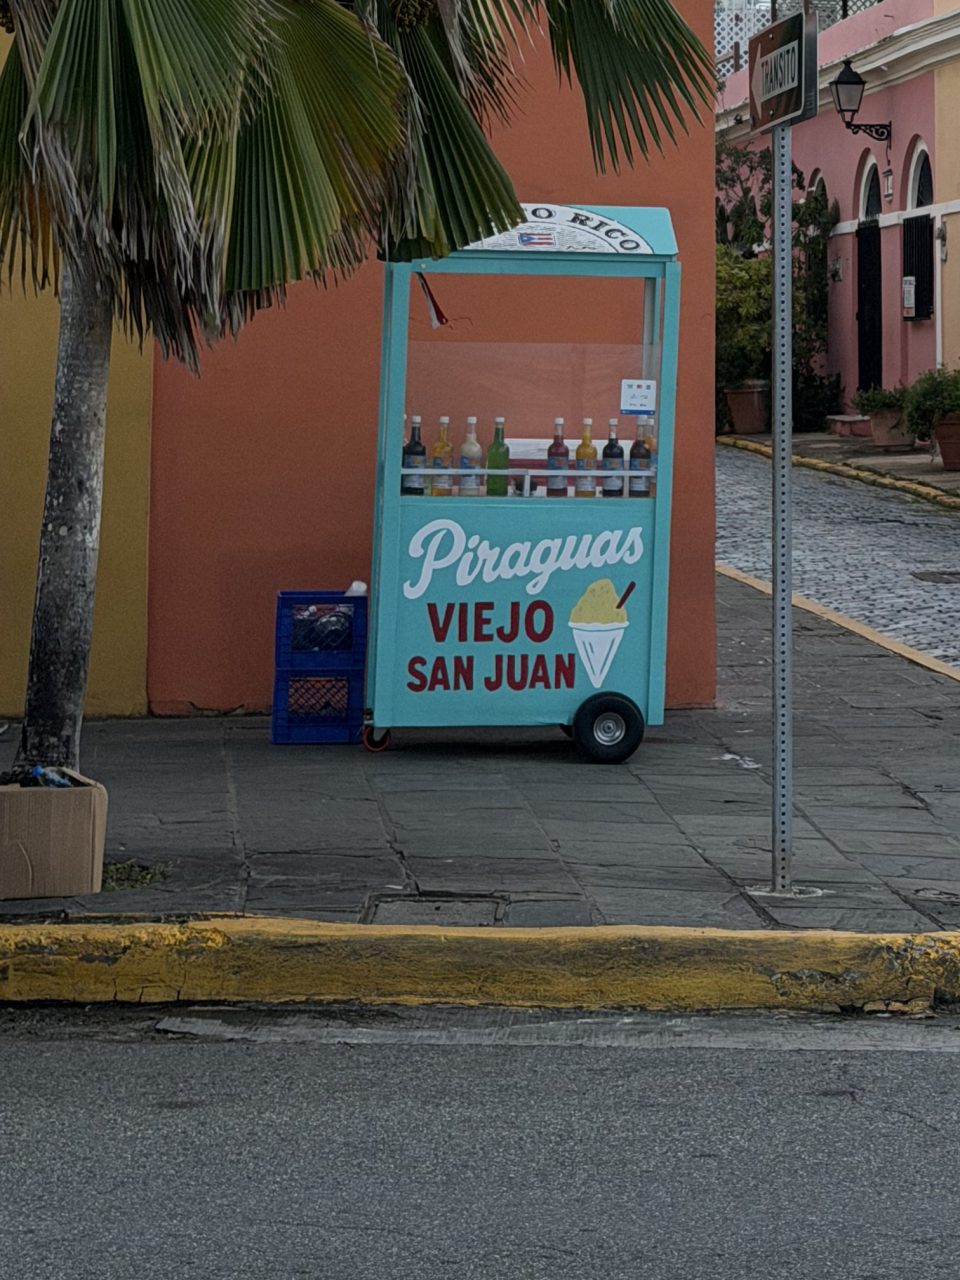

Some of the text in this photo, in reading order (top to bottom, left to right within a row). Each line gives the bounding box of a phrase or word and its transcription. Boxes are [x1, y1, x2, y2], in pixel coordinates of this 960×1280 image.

[761, 46, 796, 98] TRANSITO
[567, 212, 641, 251] RICO
[403, 519, 643, 600] Piraguas
[427, 600, 553, 643] VIEJO
[407, 653, 575, 692] SAN JUAN
